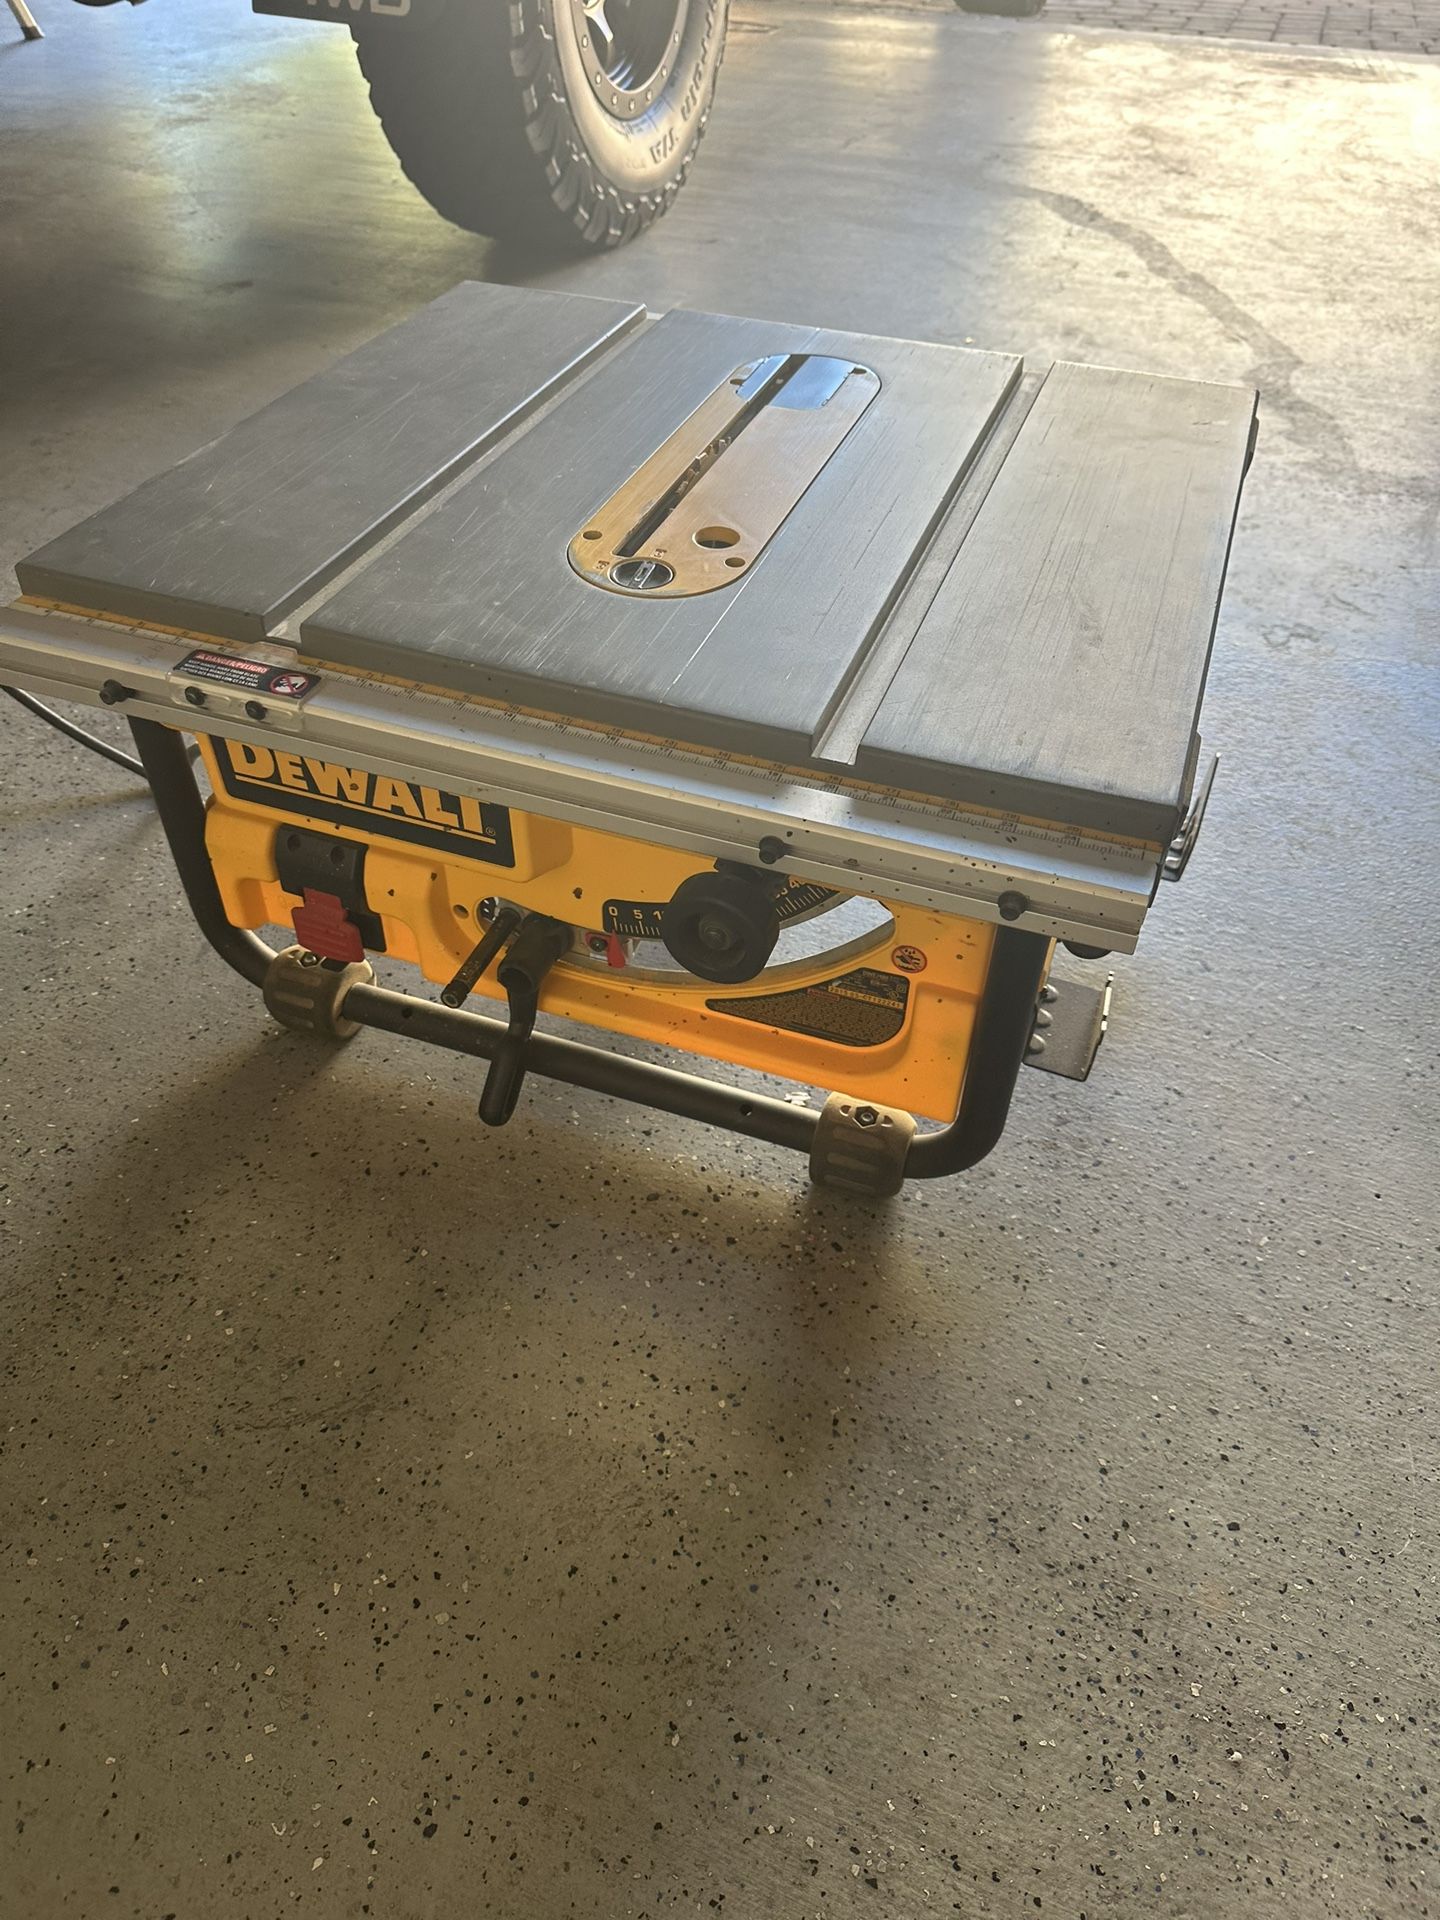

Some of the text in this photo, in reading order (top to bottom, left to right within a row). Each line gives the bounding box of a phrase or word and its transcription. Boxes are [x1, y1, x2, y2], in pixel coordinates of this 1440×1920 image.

[225, 737, 490, 834] DEWALT
[608, 905, 619, 917] 0
[633, 909, 643, 920] 5
[653, 910, 665, 921] 1
